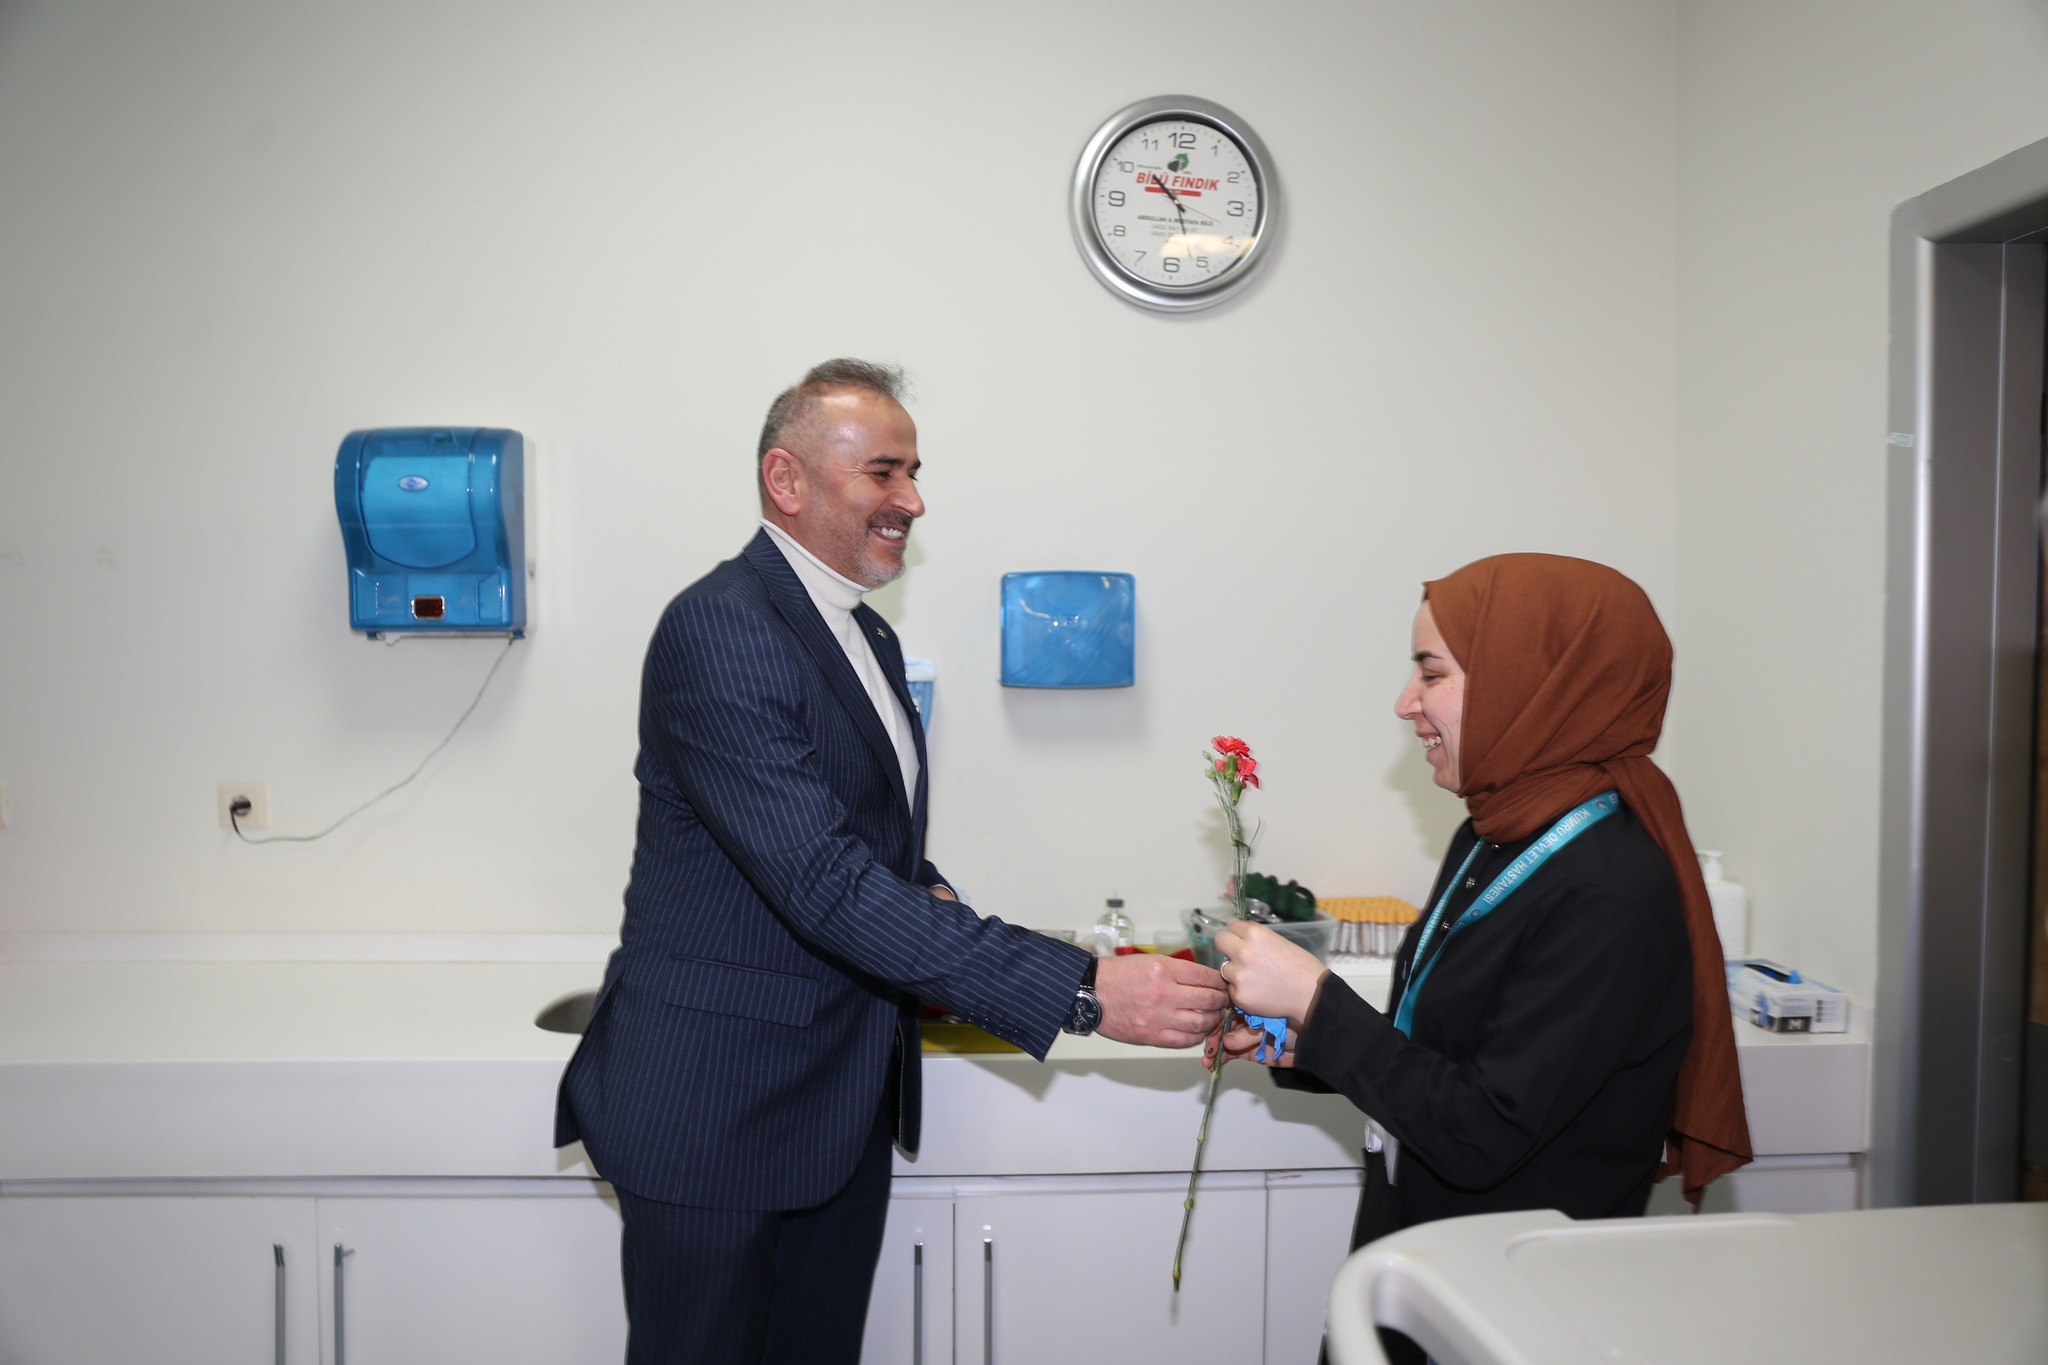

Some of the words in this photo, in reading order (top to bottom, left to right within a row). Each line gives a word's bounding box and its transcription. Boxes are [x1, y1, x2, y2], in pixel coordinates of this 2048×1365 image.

[1141, 138, 1159, 151] 11
[1168, 132, 1196, 150] 12
[1211, 145, 1219, 157] 1
[1117, 161, 1135, 173] 10
[1171, 175, 1220, 191] FINDIK
[1227, 171, 1240, 184] 2
[1108, 190, 1126, 207] 9
[1226, 200, 1245, 217] 3
[1113, 224, 1126, 237] 8
[1222, 235, 1234, 246] 4
[1134, 250, 1147, 266] 7
[1163, 256, 1180, 273] 6
[1196, 256, 1209, 269] 5
[1556, 808, 1591, 837] KUMRU
[1524, 832, 1558, 865] DEVLET
[1482, 860, 1528, 905] HASTANESİ
[1789, 1019, 1802, 1030] M
